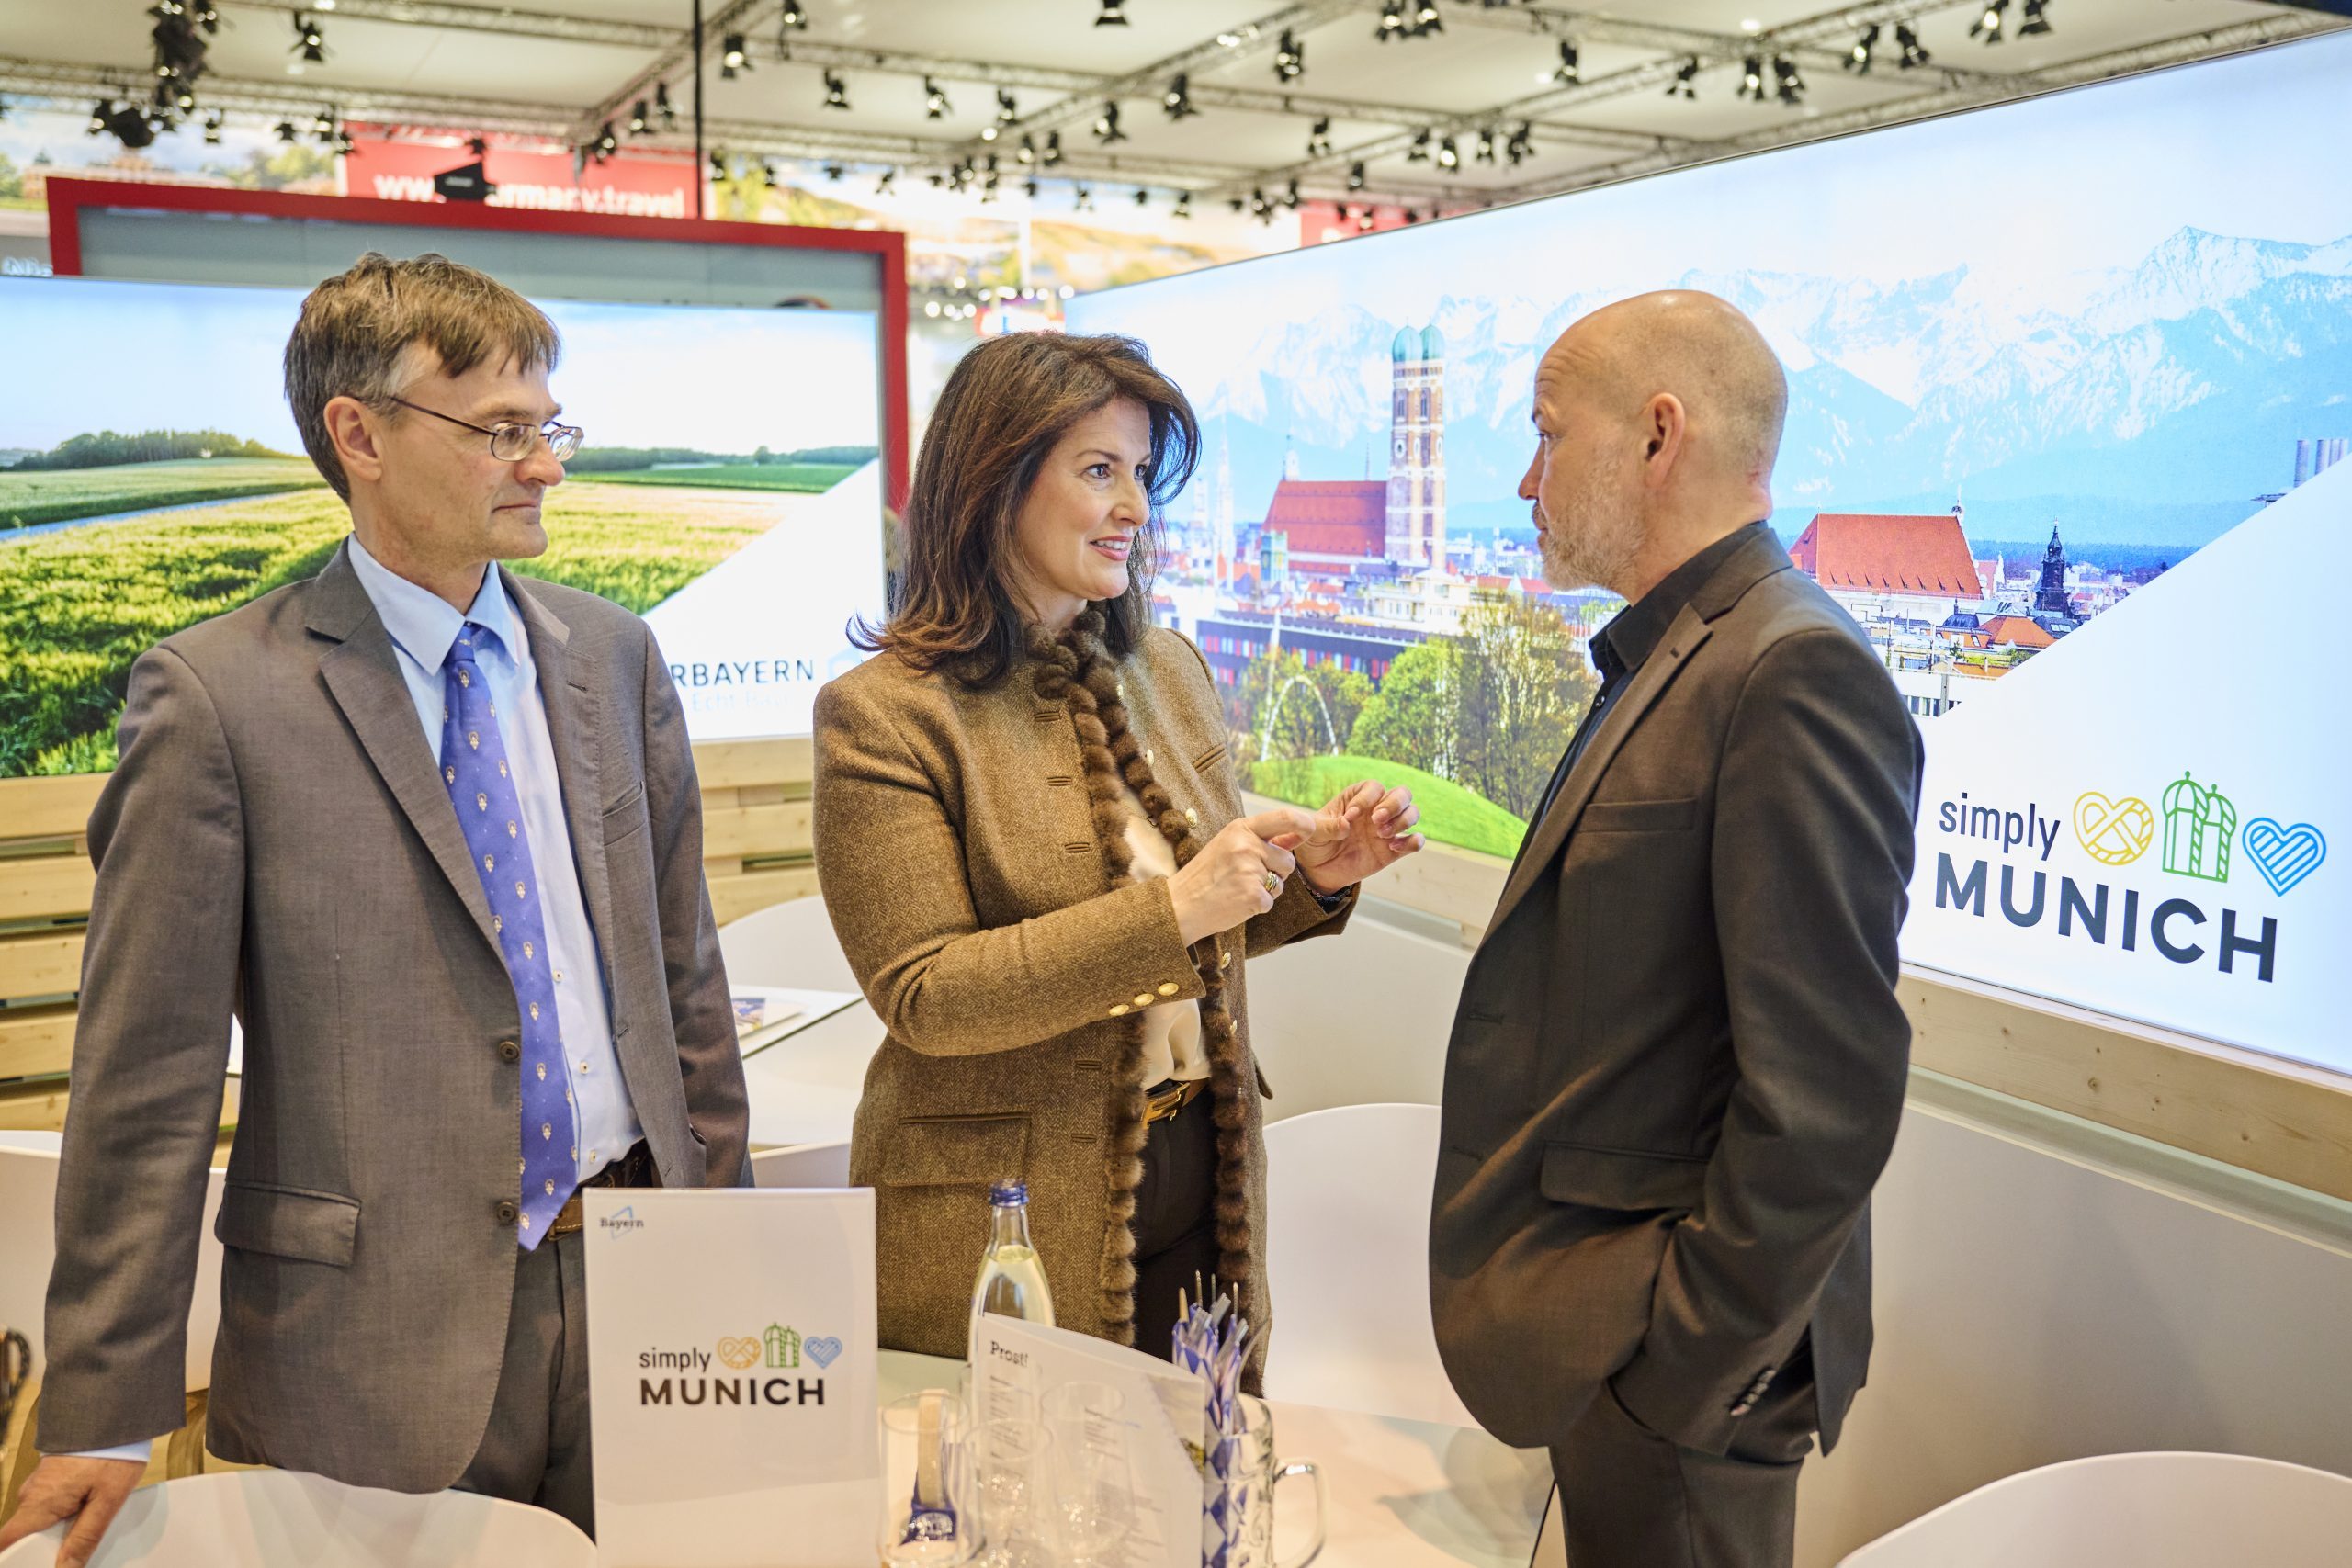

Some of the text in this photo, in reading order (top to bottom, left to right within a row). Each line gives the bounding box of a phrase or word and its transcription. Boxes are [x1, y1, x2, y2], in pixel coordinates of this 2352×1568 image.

[671, 660, 813, 687] RBAYERN
[1939, 792, 2061, 861] simply
[1935, 852, 2278, 983] MUNICH
[599, 1217, 645, 1231] Bayern
[639, 1347, 711, 1373] simply
[640, 1378, 825, 1405] MUNICH
